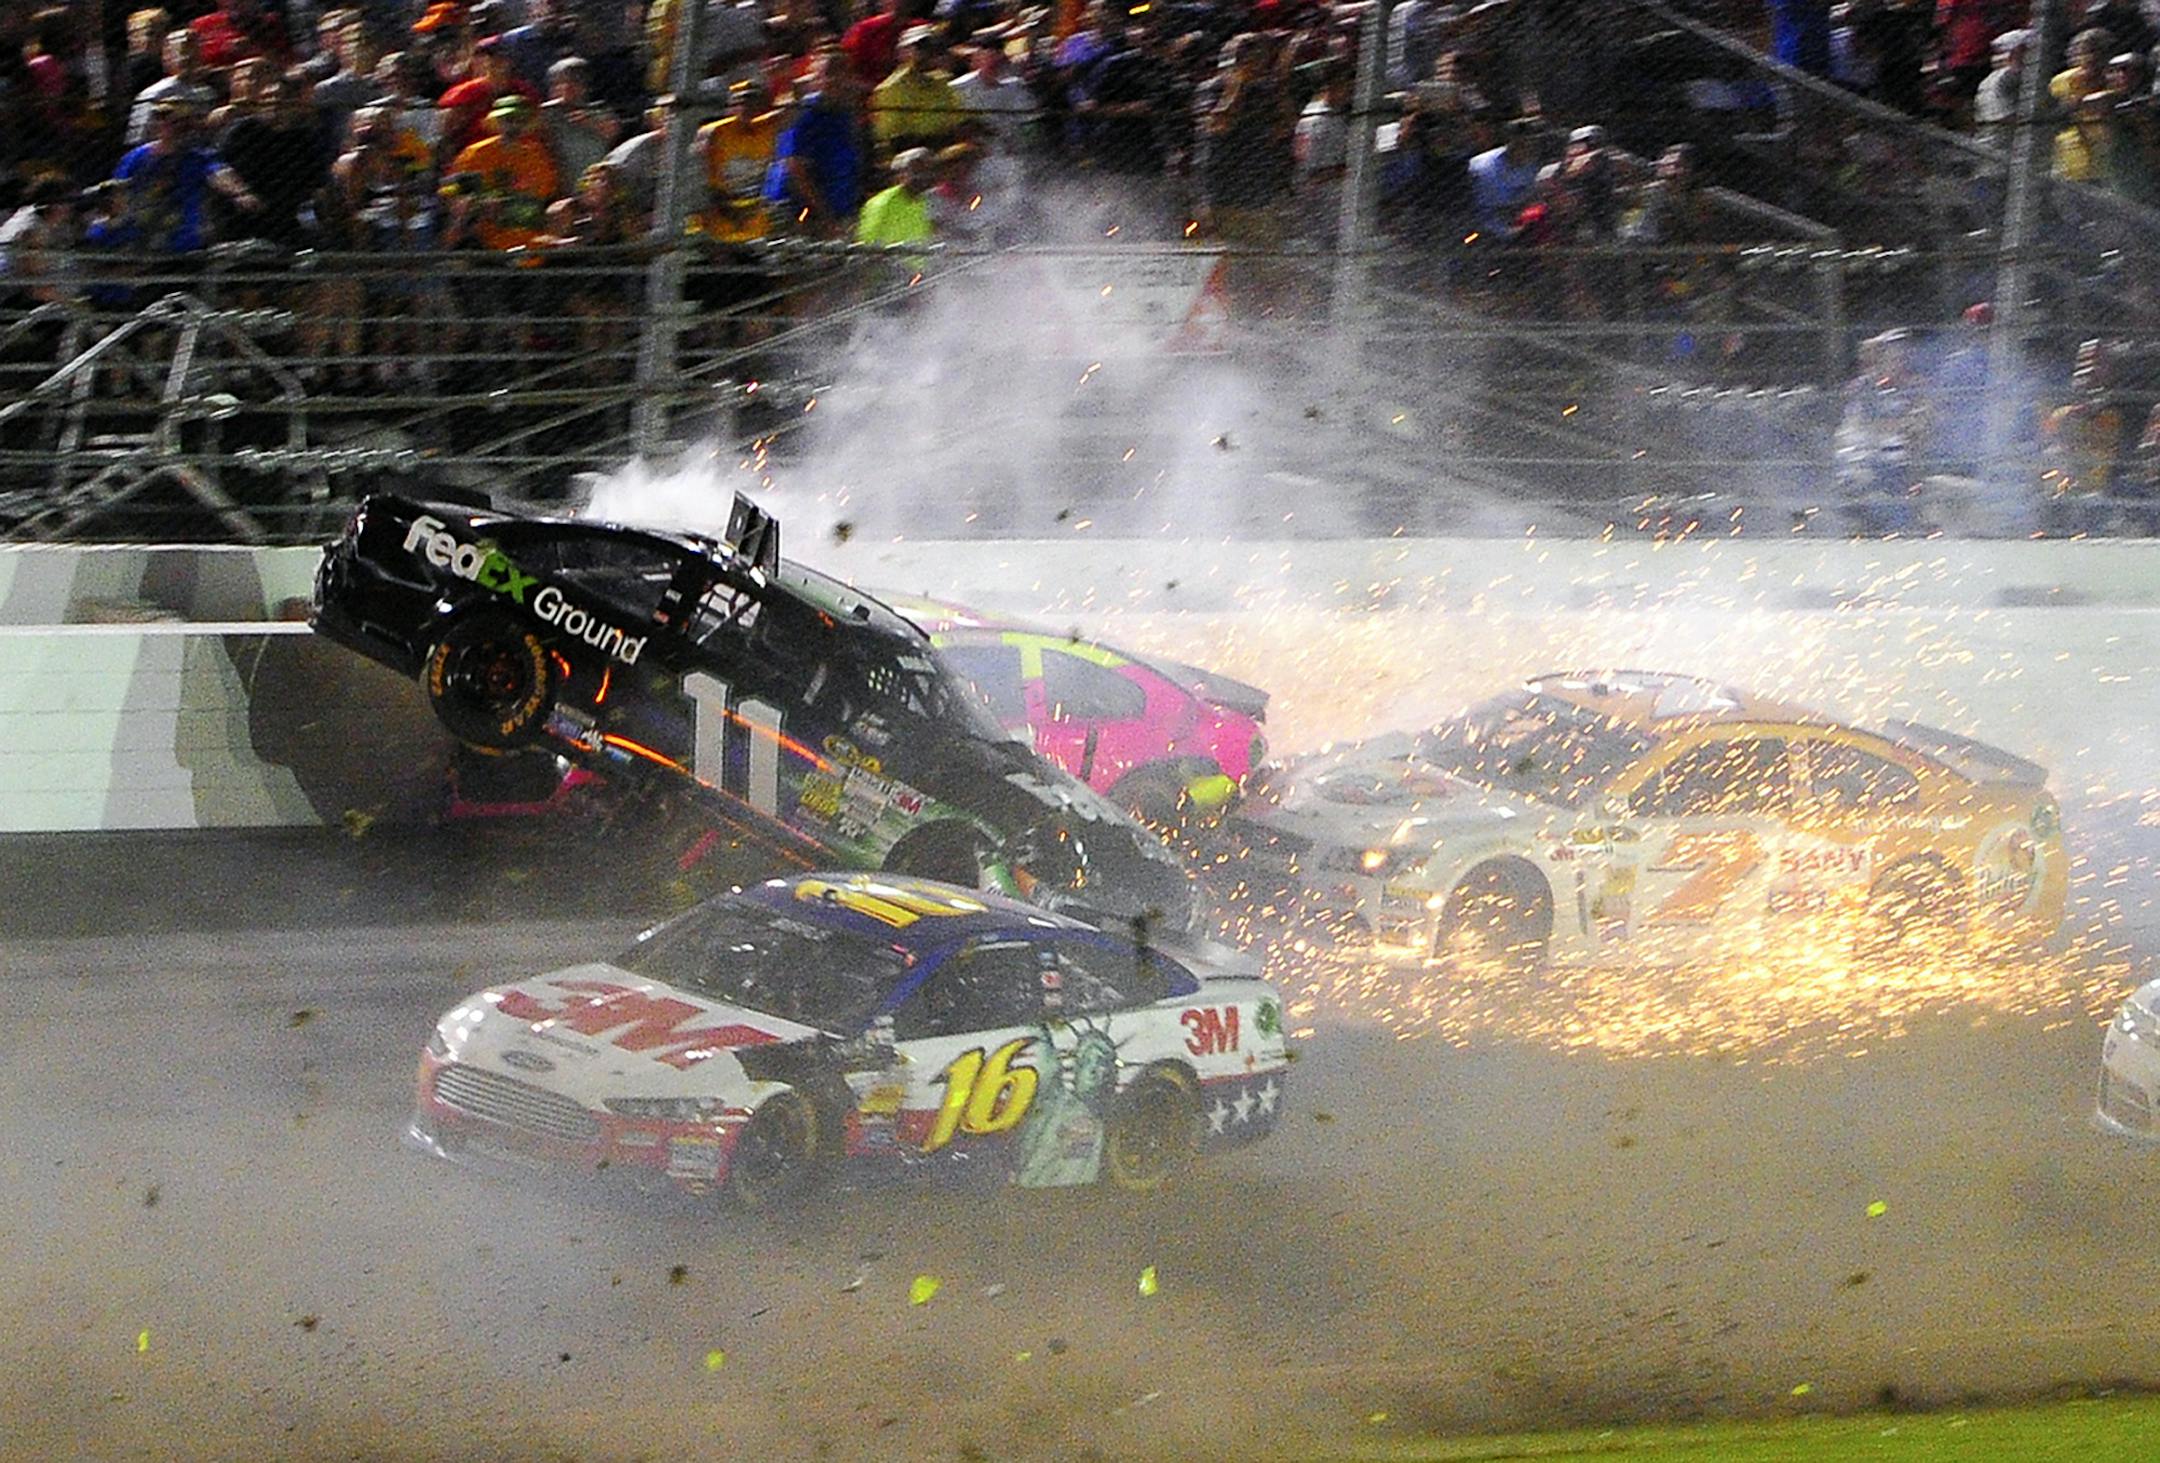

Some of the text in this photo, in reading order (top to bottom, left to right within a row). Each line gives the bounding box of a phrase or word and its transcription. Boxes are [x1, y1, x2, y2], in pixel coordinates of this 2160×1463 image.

[403, 515, 647, 666] FedEx Ground
[683, 672, 782, 817] 11
[924, 1038, 1038, 1153] 16
[1180, 1006, 1239, 1056] 3M
